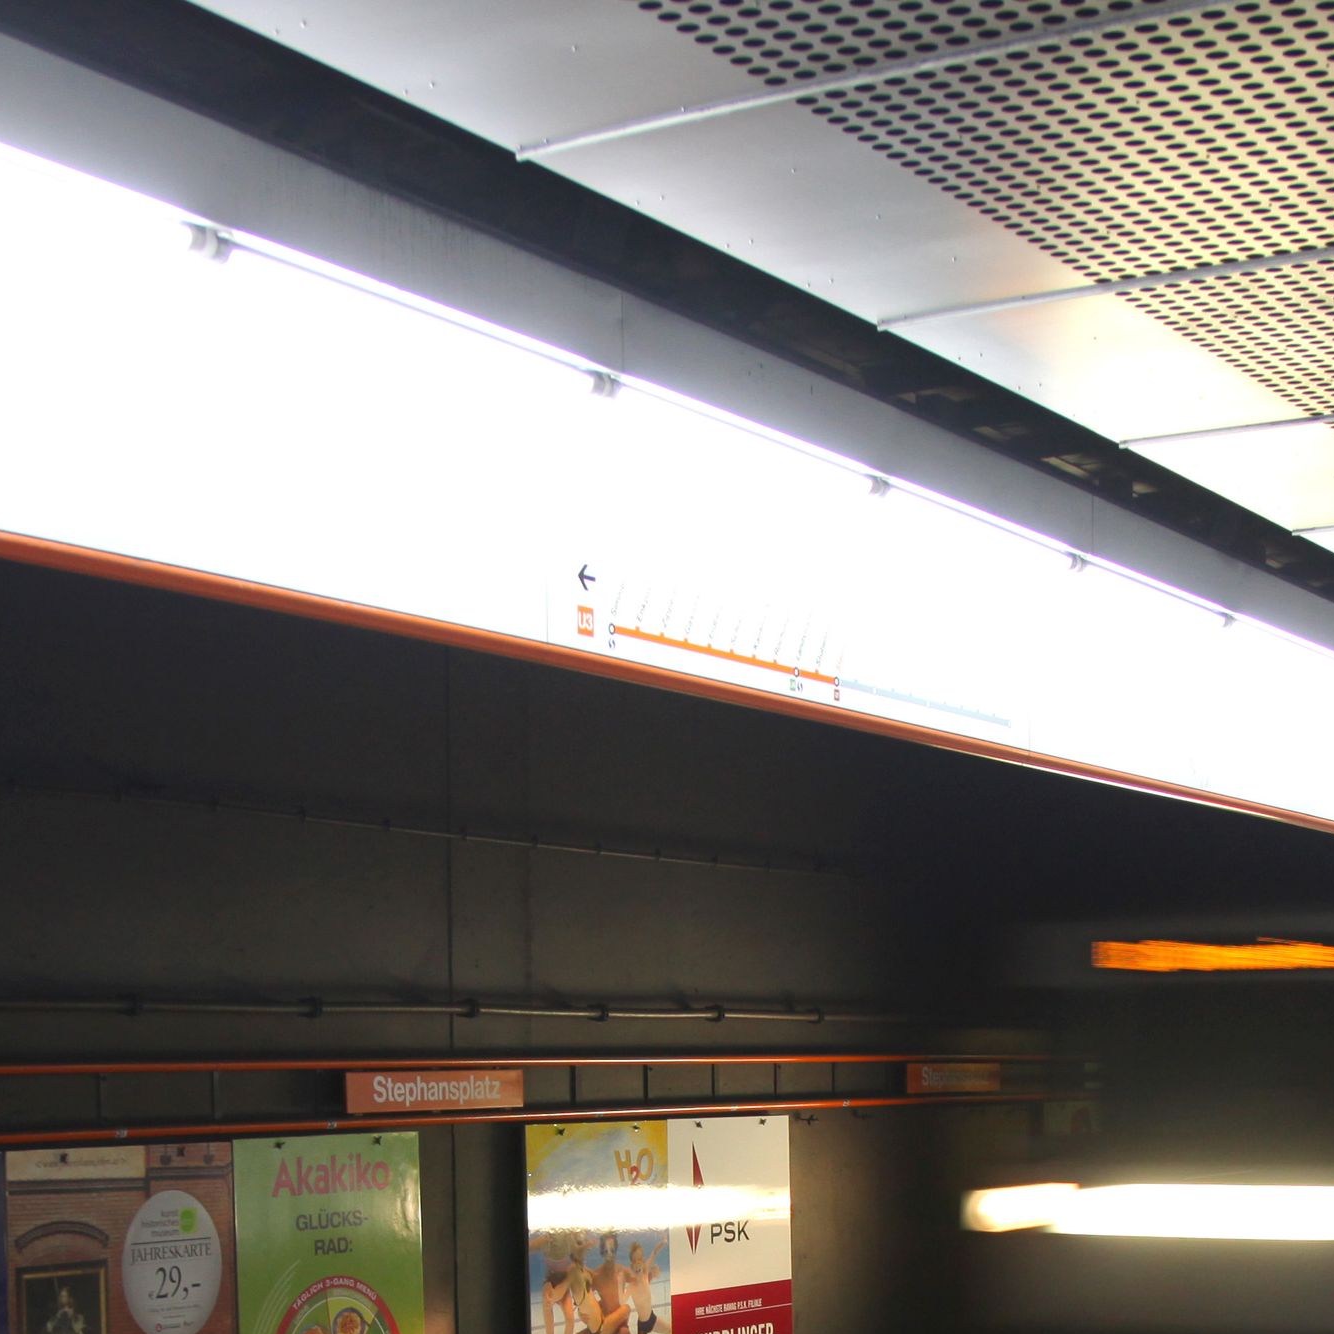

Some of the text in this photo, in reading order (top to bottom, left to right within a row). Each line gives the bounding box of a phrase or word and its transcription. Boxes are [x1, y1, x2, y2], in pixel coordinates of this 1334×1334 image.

[578, 611, 593, 631] U3
[373, 1075, 501, 1107] Stephansplatz
[271, 1152, 392, 1198] Akakiko
[614, 1147, 654, 1186] H2O
[295, 1208, 368, 1232] GLÜCKS-
[710, 1220, 750, 1244] PSK
[130, 1242, 212, 1266] JAHRESKARTE
[314, 1236, 353, 1256] RAD:
[292, 1281, 324, 1311] TÄGLICH
[325, 1277, 355, 1288] 3-GANG
[356, 1281, 379, 1302] MENÜ
